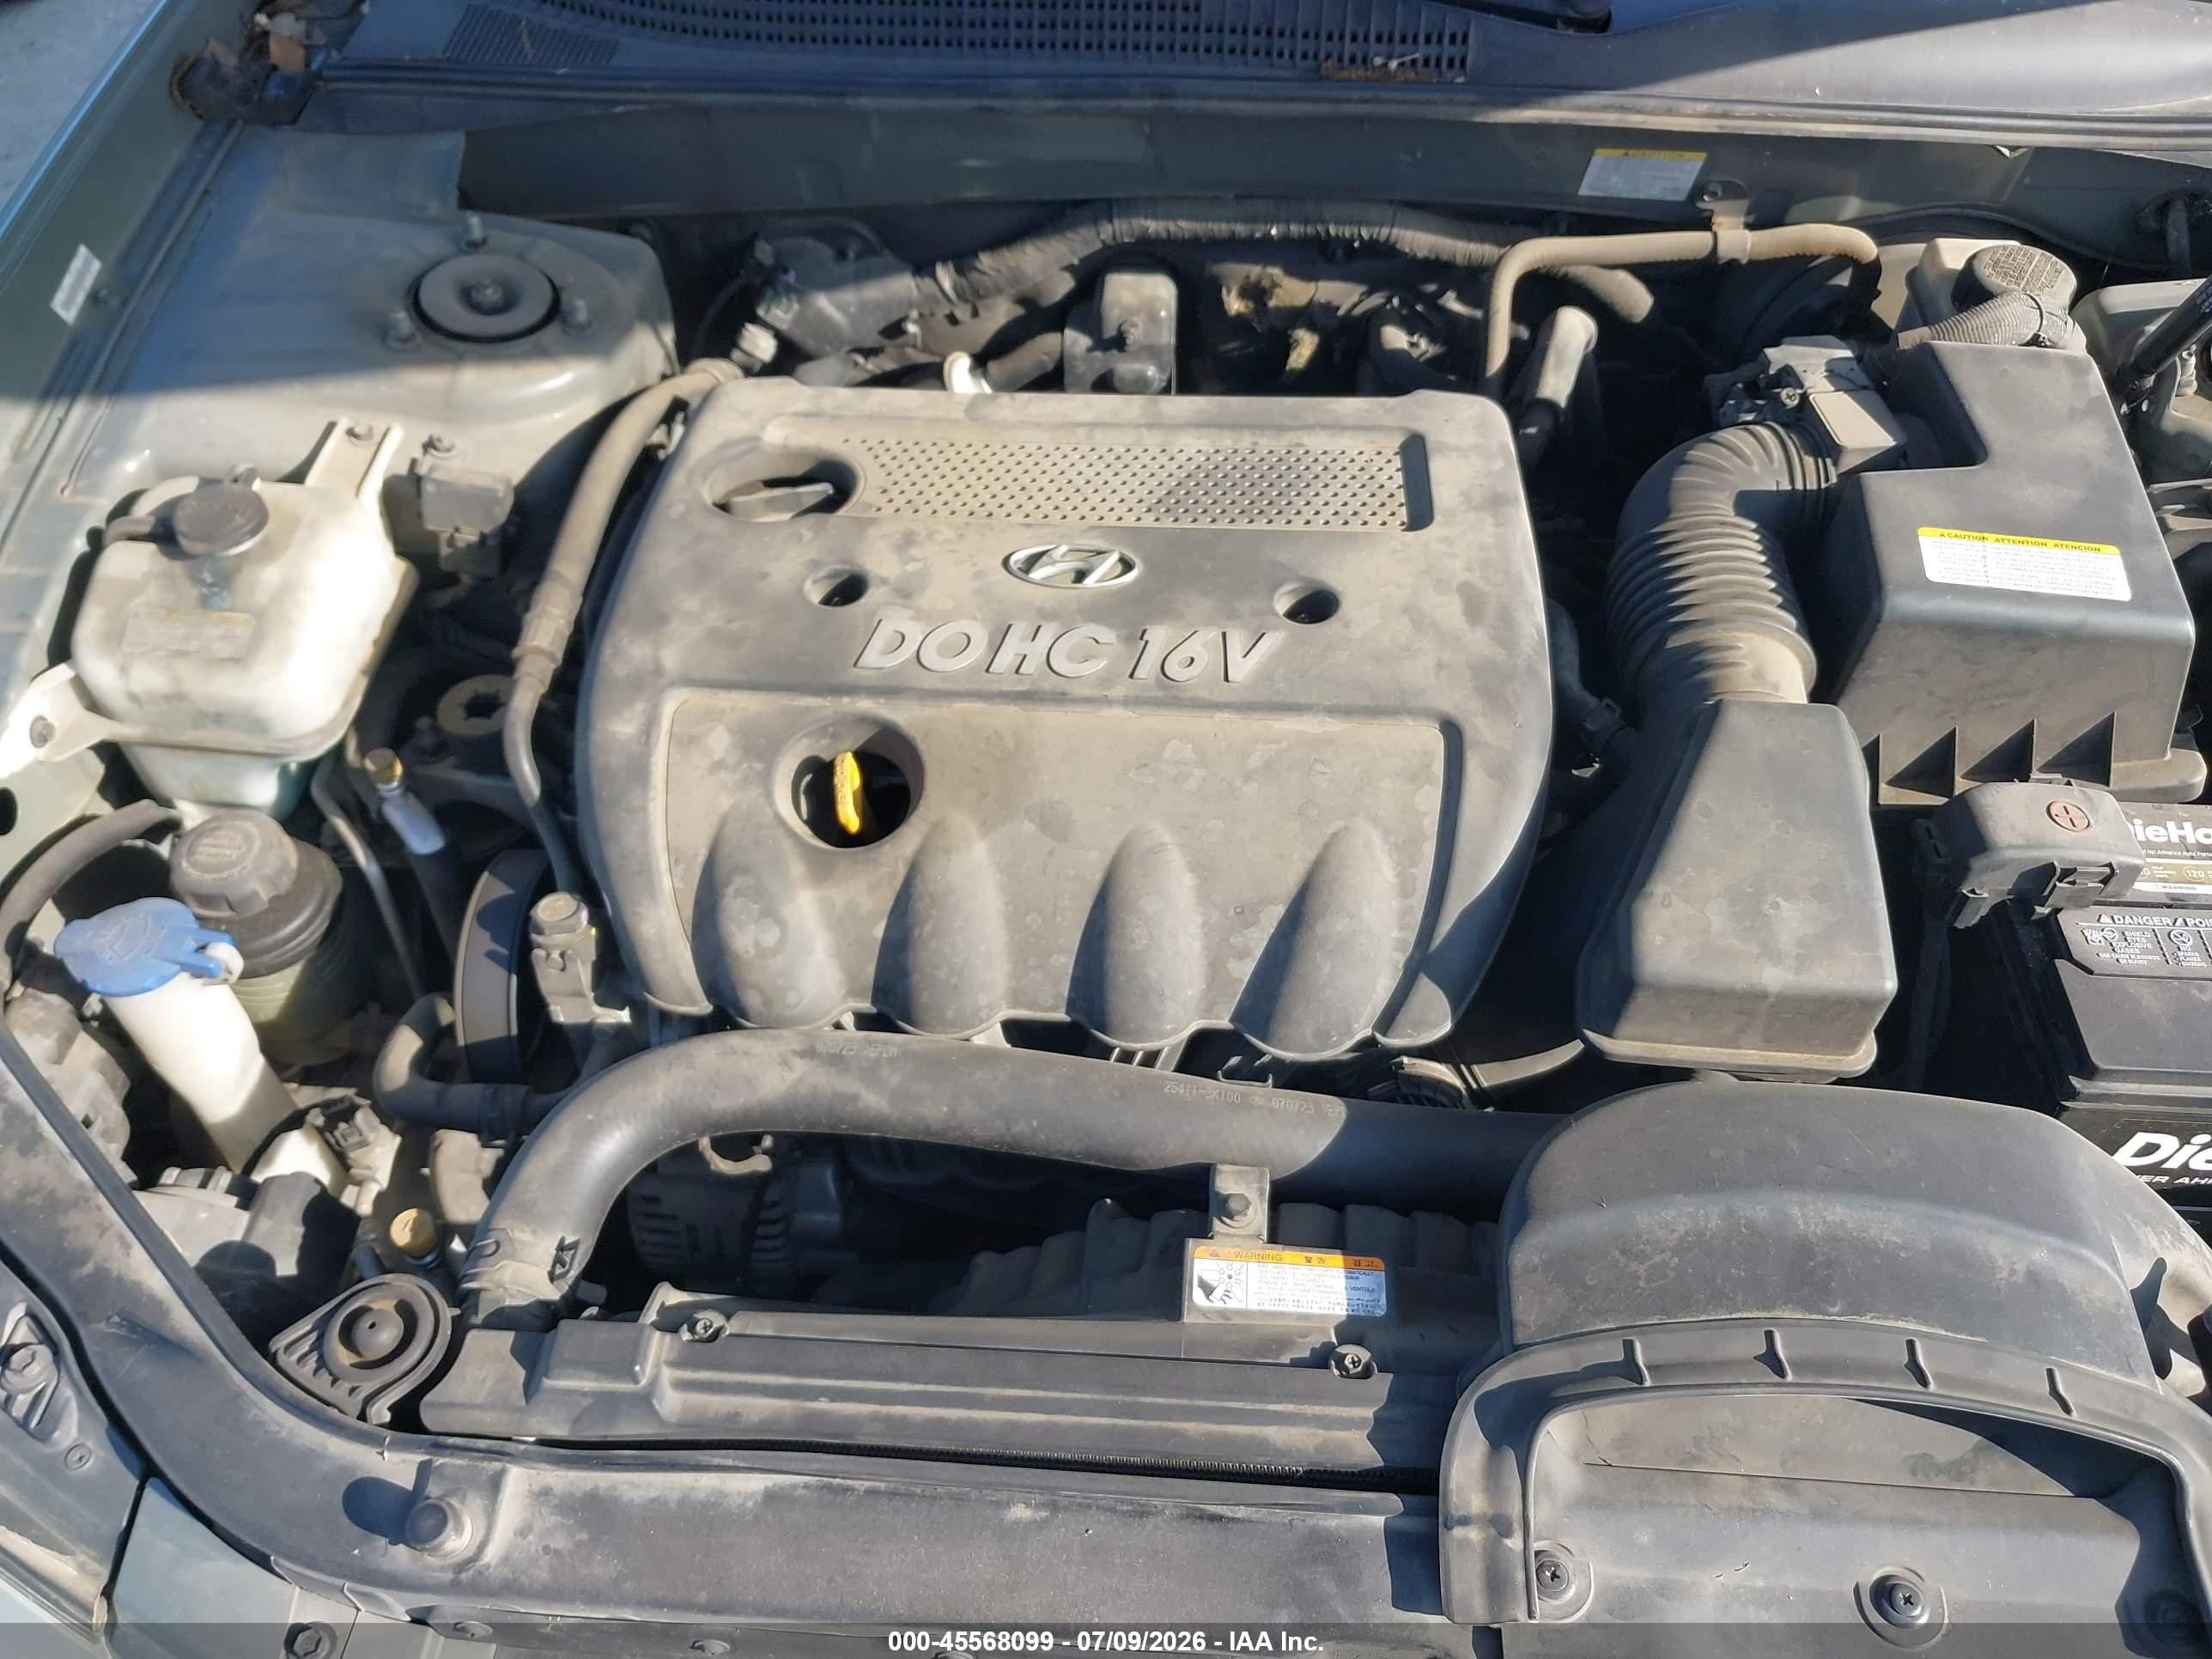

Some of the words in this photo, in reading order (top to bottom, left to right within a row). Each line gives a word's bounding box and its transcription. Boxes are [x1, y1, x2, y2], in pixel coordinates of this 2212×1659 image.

[1945, 532, 1989, 543] CAUTION
[1995, 537, 2047, 548] ATTENTION
[854, 617, 1115, 679] DOHC
[1128, 625, 1283, 684] 16V
[2186, 869, 2205, 879] 120
[2113, 915, 2172, 927] DANGER
[2112, 1132, 2212, 1171] Die
[1234, 1250, 1283, 1262] WARNING
